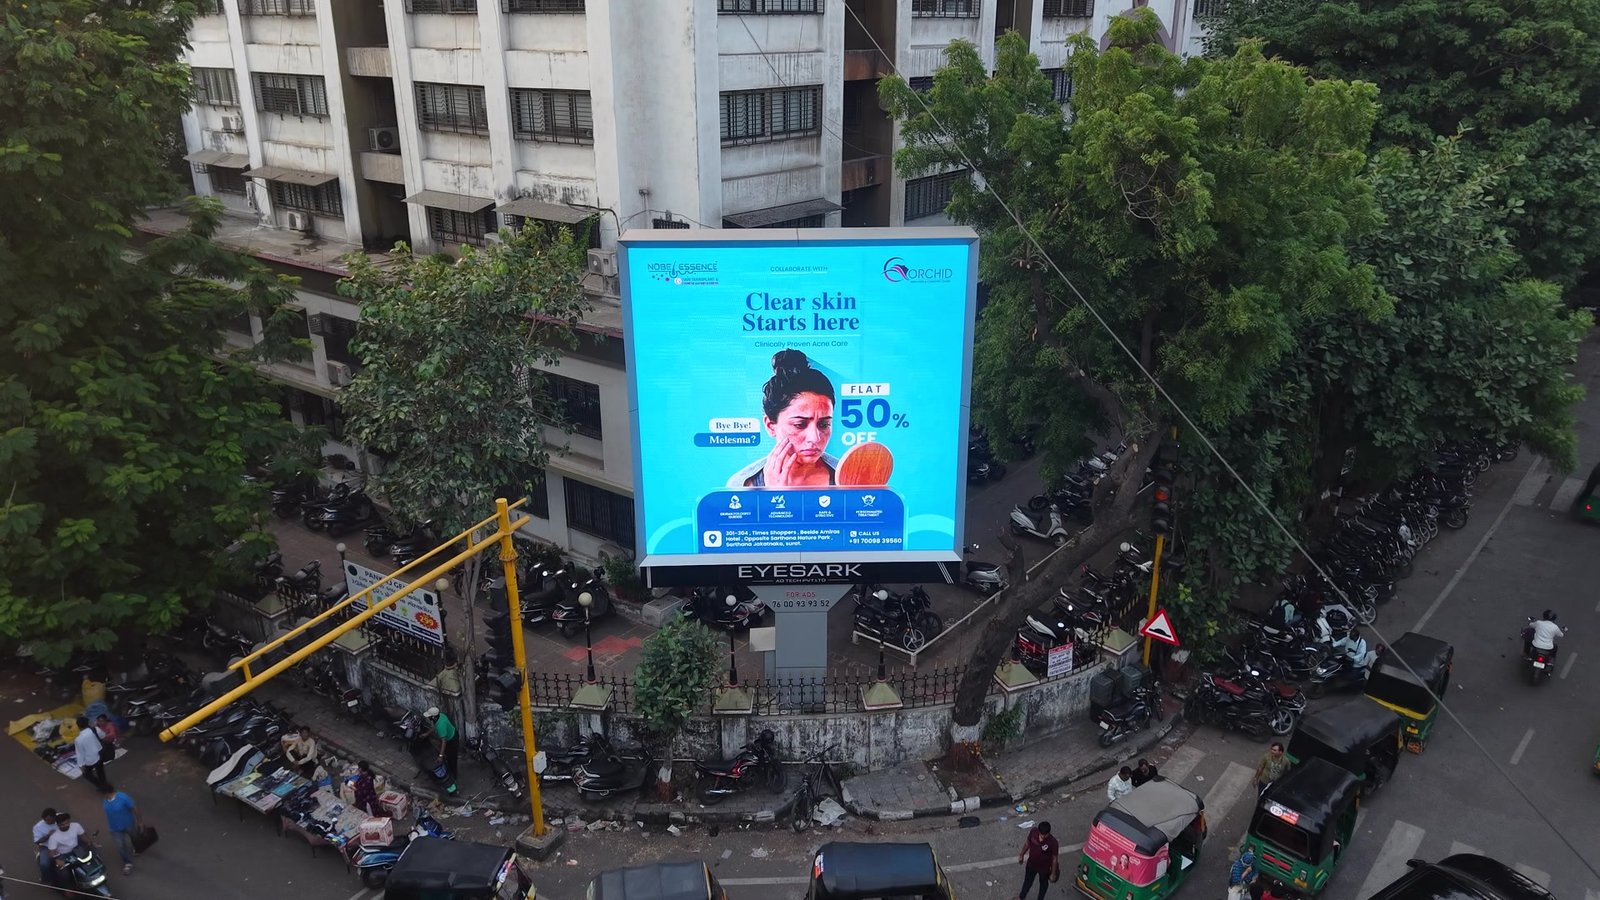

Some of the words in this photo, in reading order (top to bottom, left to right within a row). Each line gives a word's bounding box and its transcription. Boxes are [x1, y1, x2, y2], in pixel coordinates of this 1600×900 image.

[678, 263, 718, 271] ESSENCE
[907, 268, 953, 280] ORCHID
[745, 292, 805, 311] Clear
[812, 291, 856, 310] skin
[742, 313, 806, 331] Starts
[813, 312, 860, 331] here
[850, 384, 882, 394] FLAT
[715, 421, 731, 430] Bye
[733, 420, 752, 430] Bye!
[709, 435, 756, 444] Melesma?
[841, 431, 878, 446] OFF
[738, 564, 862, 578] EYESARK
[783, 600, 793, 608] 00
[796, 600, 805, 608] 93
[820, 599, 830, 607] 52
